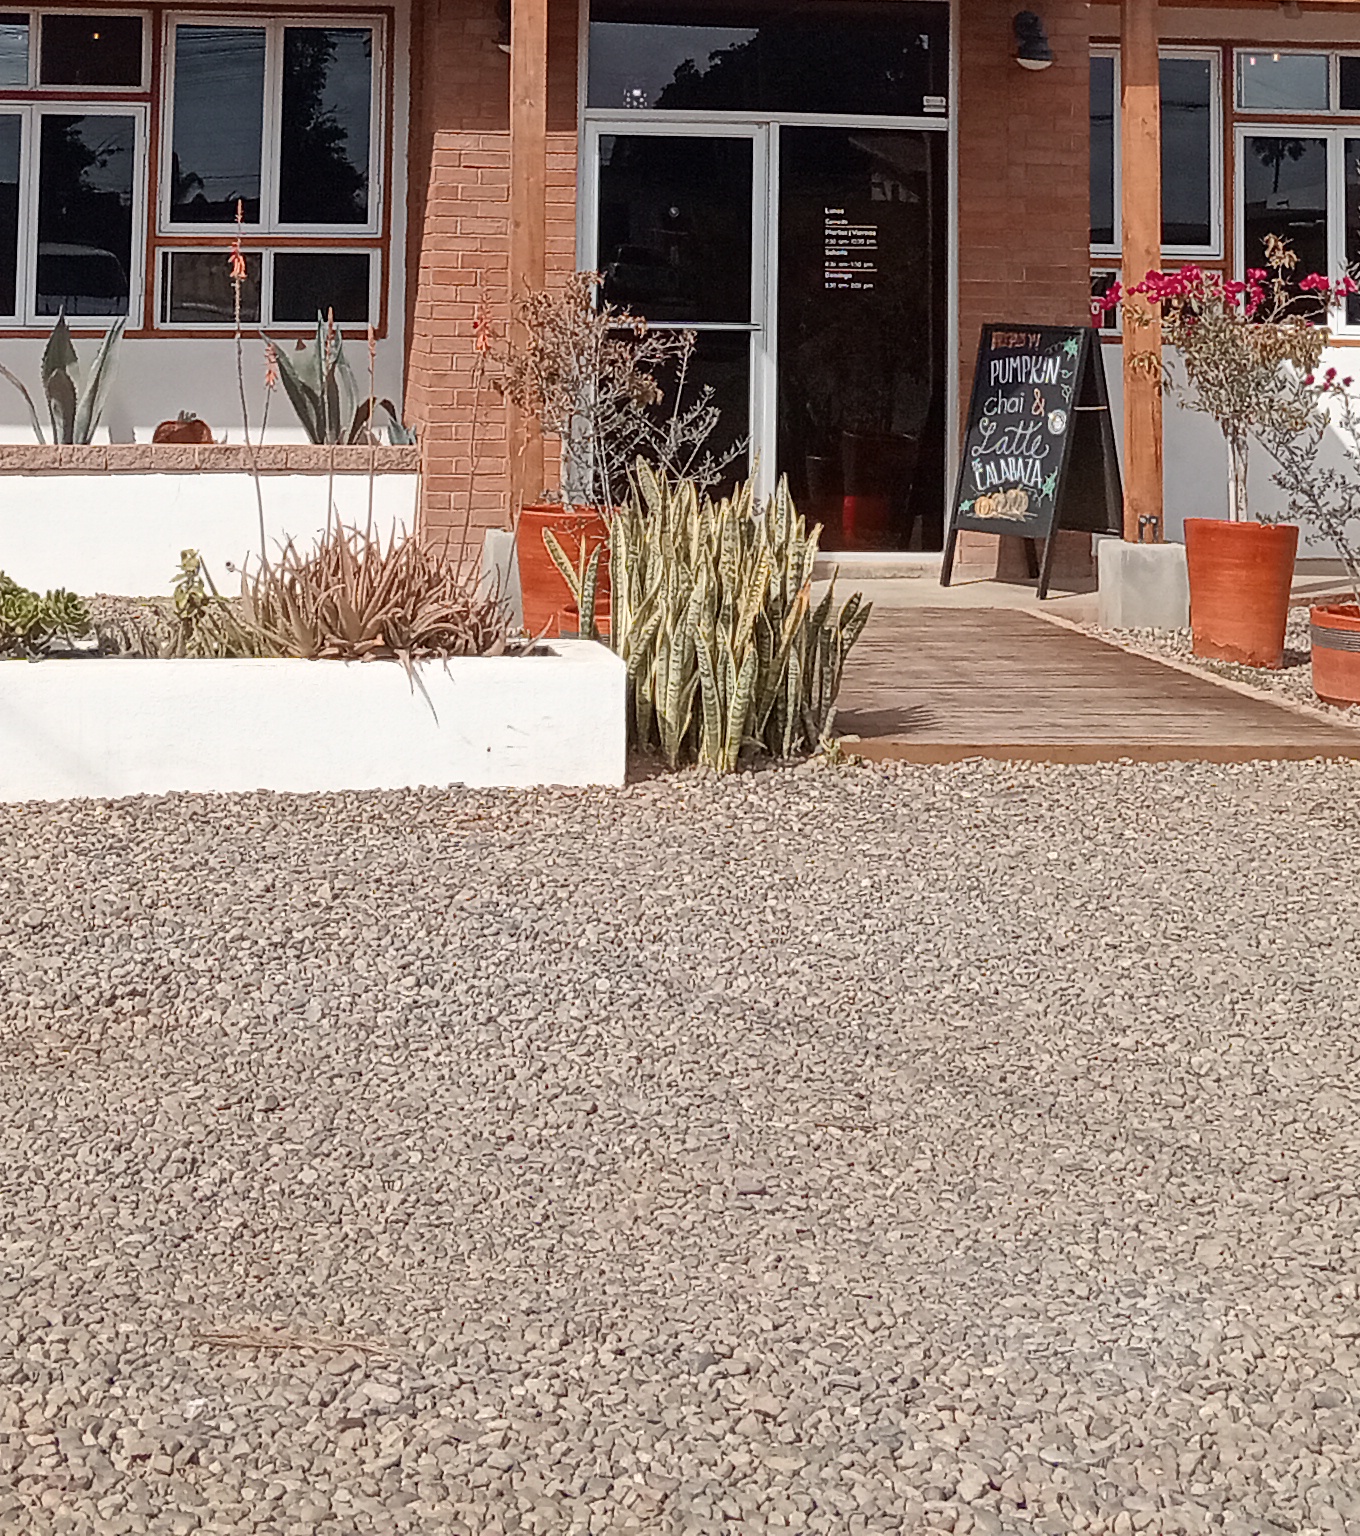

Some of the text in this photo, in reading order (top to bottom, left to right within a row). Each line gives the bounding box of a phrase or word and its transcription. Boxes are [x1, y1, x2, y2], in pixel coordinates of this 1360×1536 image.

[990, 355, 1061, 386] PUMPKIN
[983, 388, 1045, 416] chai &
[971, 416, 1050, 459] Latte
[975, 457, 1043, 491] CALABAZA
